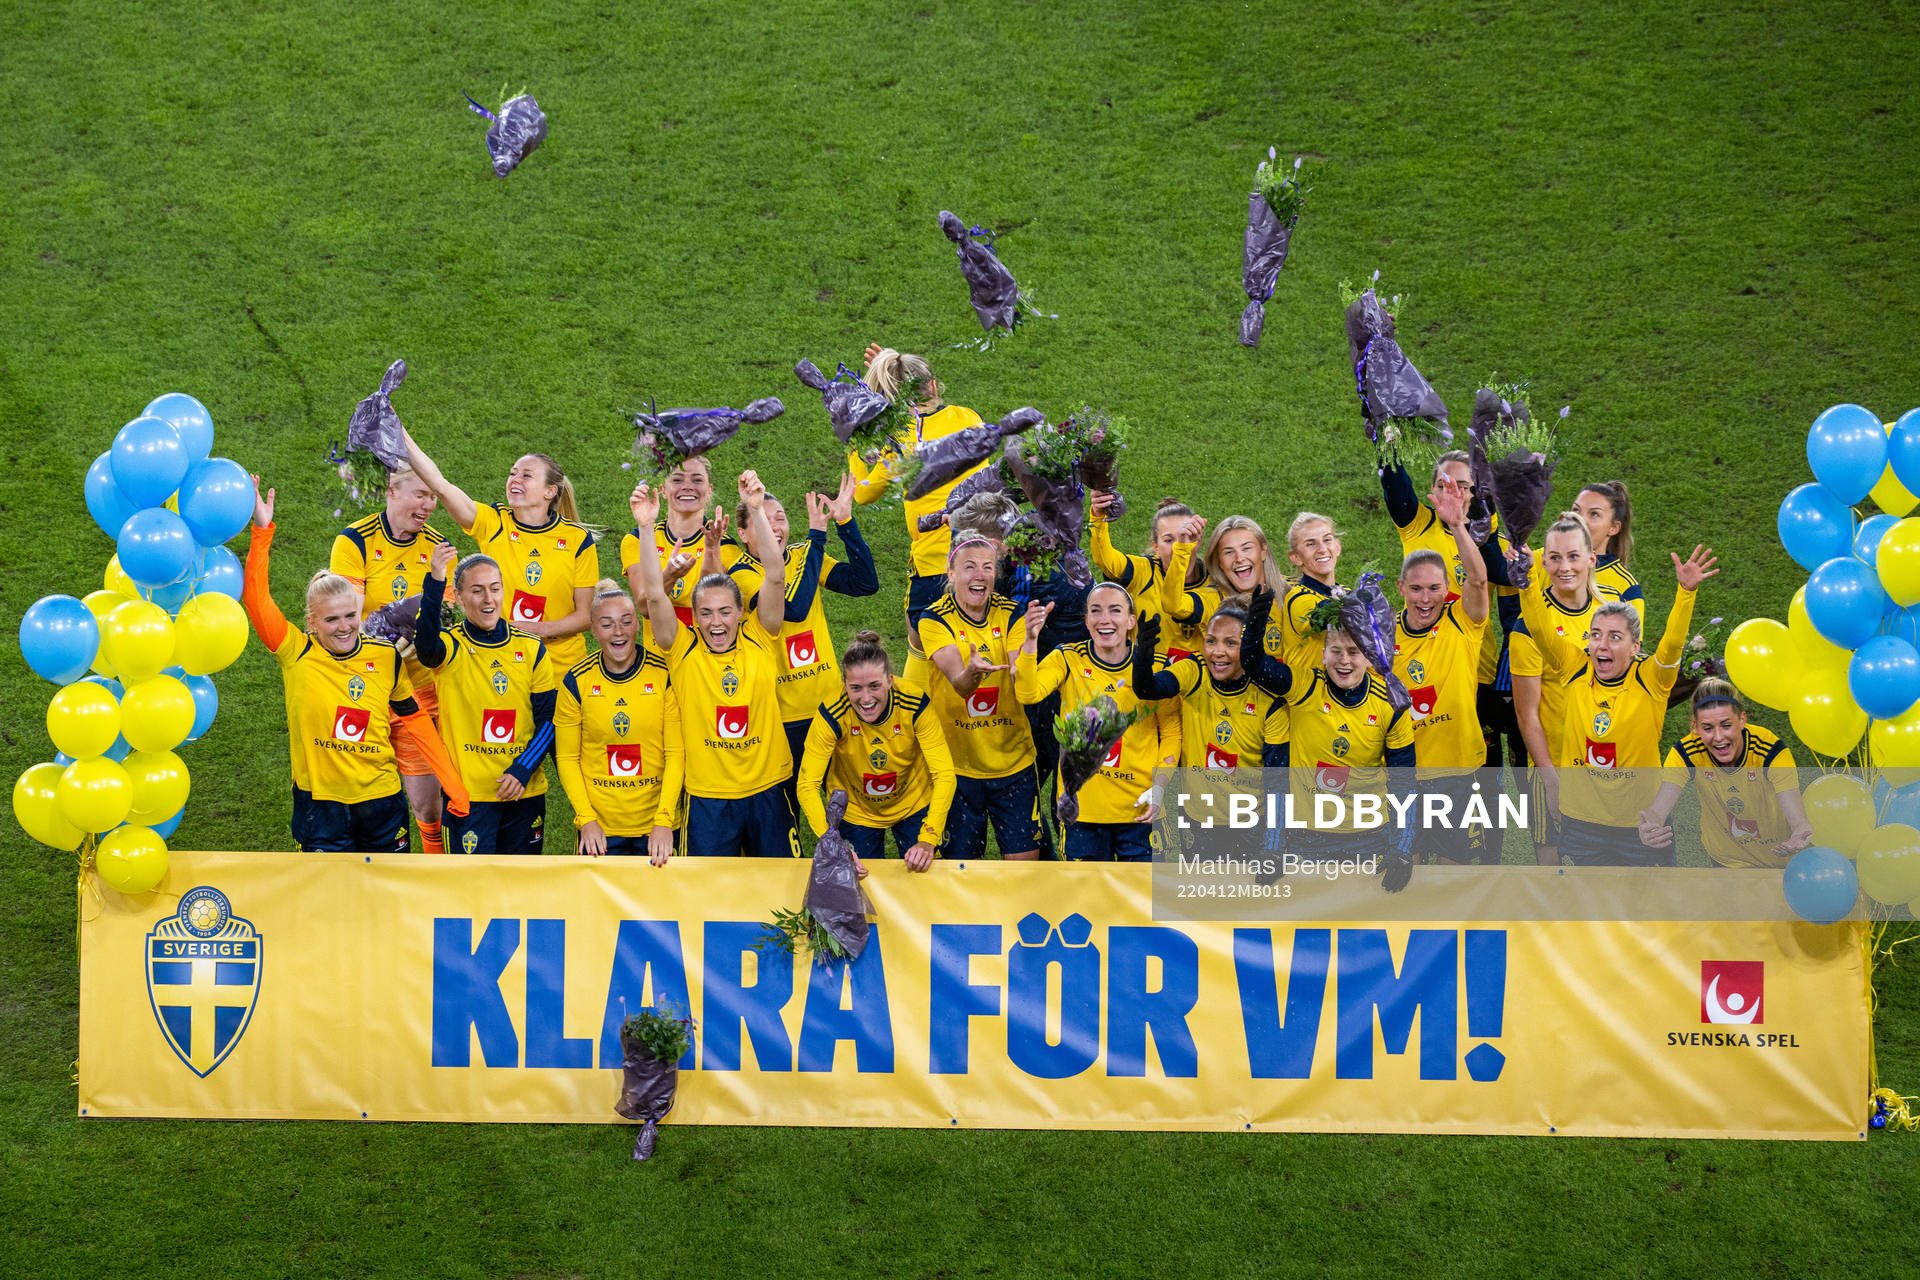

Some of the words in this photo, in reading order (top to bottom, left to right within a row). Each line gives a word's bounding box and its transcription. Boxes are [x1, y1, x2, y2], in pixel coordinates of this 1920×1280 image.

[777, 669, 815, 684] SVENSKA
[992, 718, 1015, 727] SPEL
[1430, 713, 1452, 725] SPEL
[314, 738, 356, 753] SVENSKA
[360, 745, 381, 753] SPEL
[464, 744, 506, 755] SVENSKA
[593, 778, 635, 788] SVENSKA
[638, 776, 660, 787] SPEL
[1114, 771, 1135, 780] SPEL
[788, 827, 801, 858] 6
[1149, 830, 1163, 855] 9
[163, 943, 244, 956] SVERIGE
[431, 917, 895, 1074] KLARA
[929, 912, 1199, 1079] FÖR
[1233, 928, 1508, 1082] VM!
[1667, 1032, 1750, 1047] SVENSKA
[1756, 1033, 1800, 1048] SPEL
